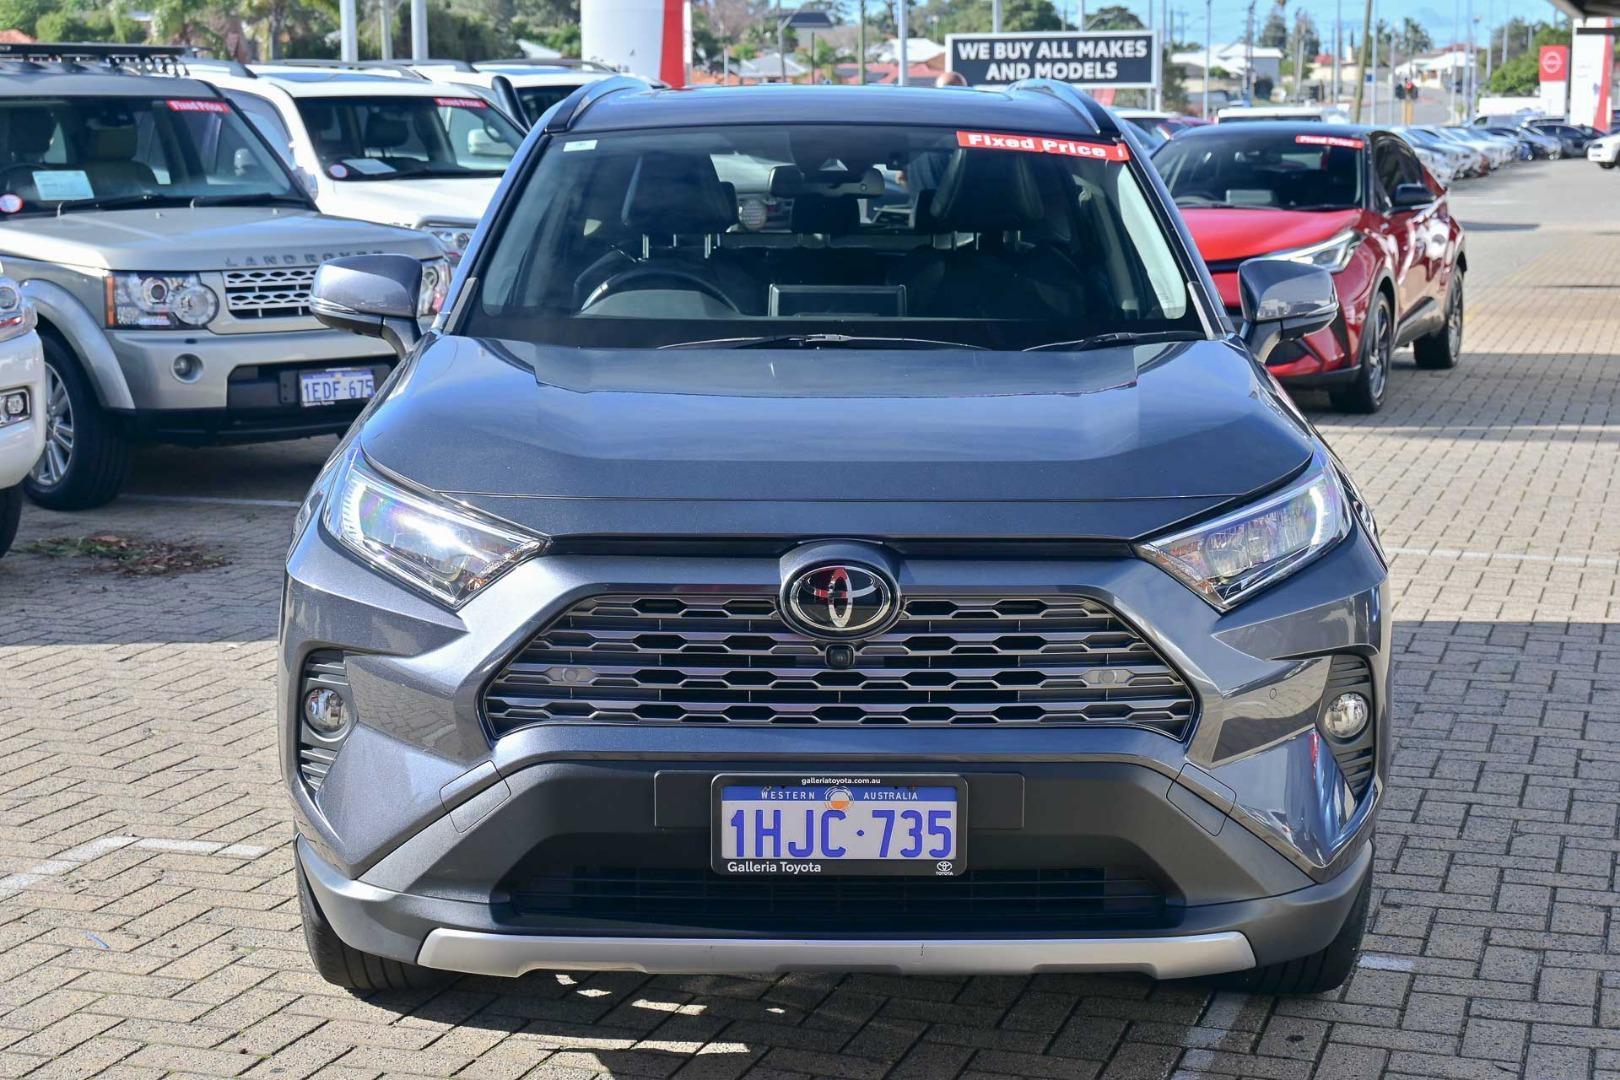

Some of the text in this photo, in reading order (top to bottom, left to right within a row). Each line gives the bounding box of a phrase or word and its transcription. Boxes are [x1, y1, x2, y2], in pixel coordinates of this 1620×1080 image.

[957, 39, 1147, 60] WE BUY ALL MAKES
[985, 61, 1118, 80] AND MODELS
[968, 133, 1107, 157] Fixed Price
[225, 254, 297, 267] LAND
[801, 777, 881, 785] galleriatoyota.com.au
[761, 791, 918, 800] WESTERN AUSTRALIA
[727, 861, 822, 875] Galleria Toyota
